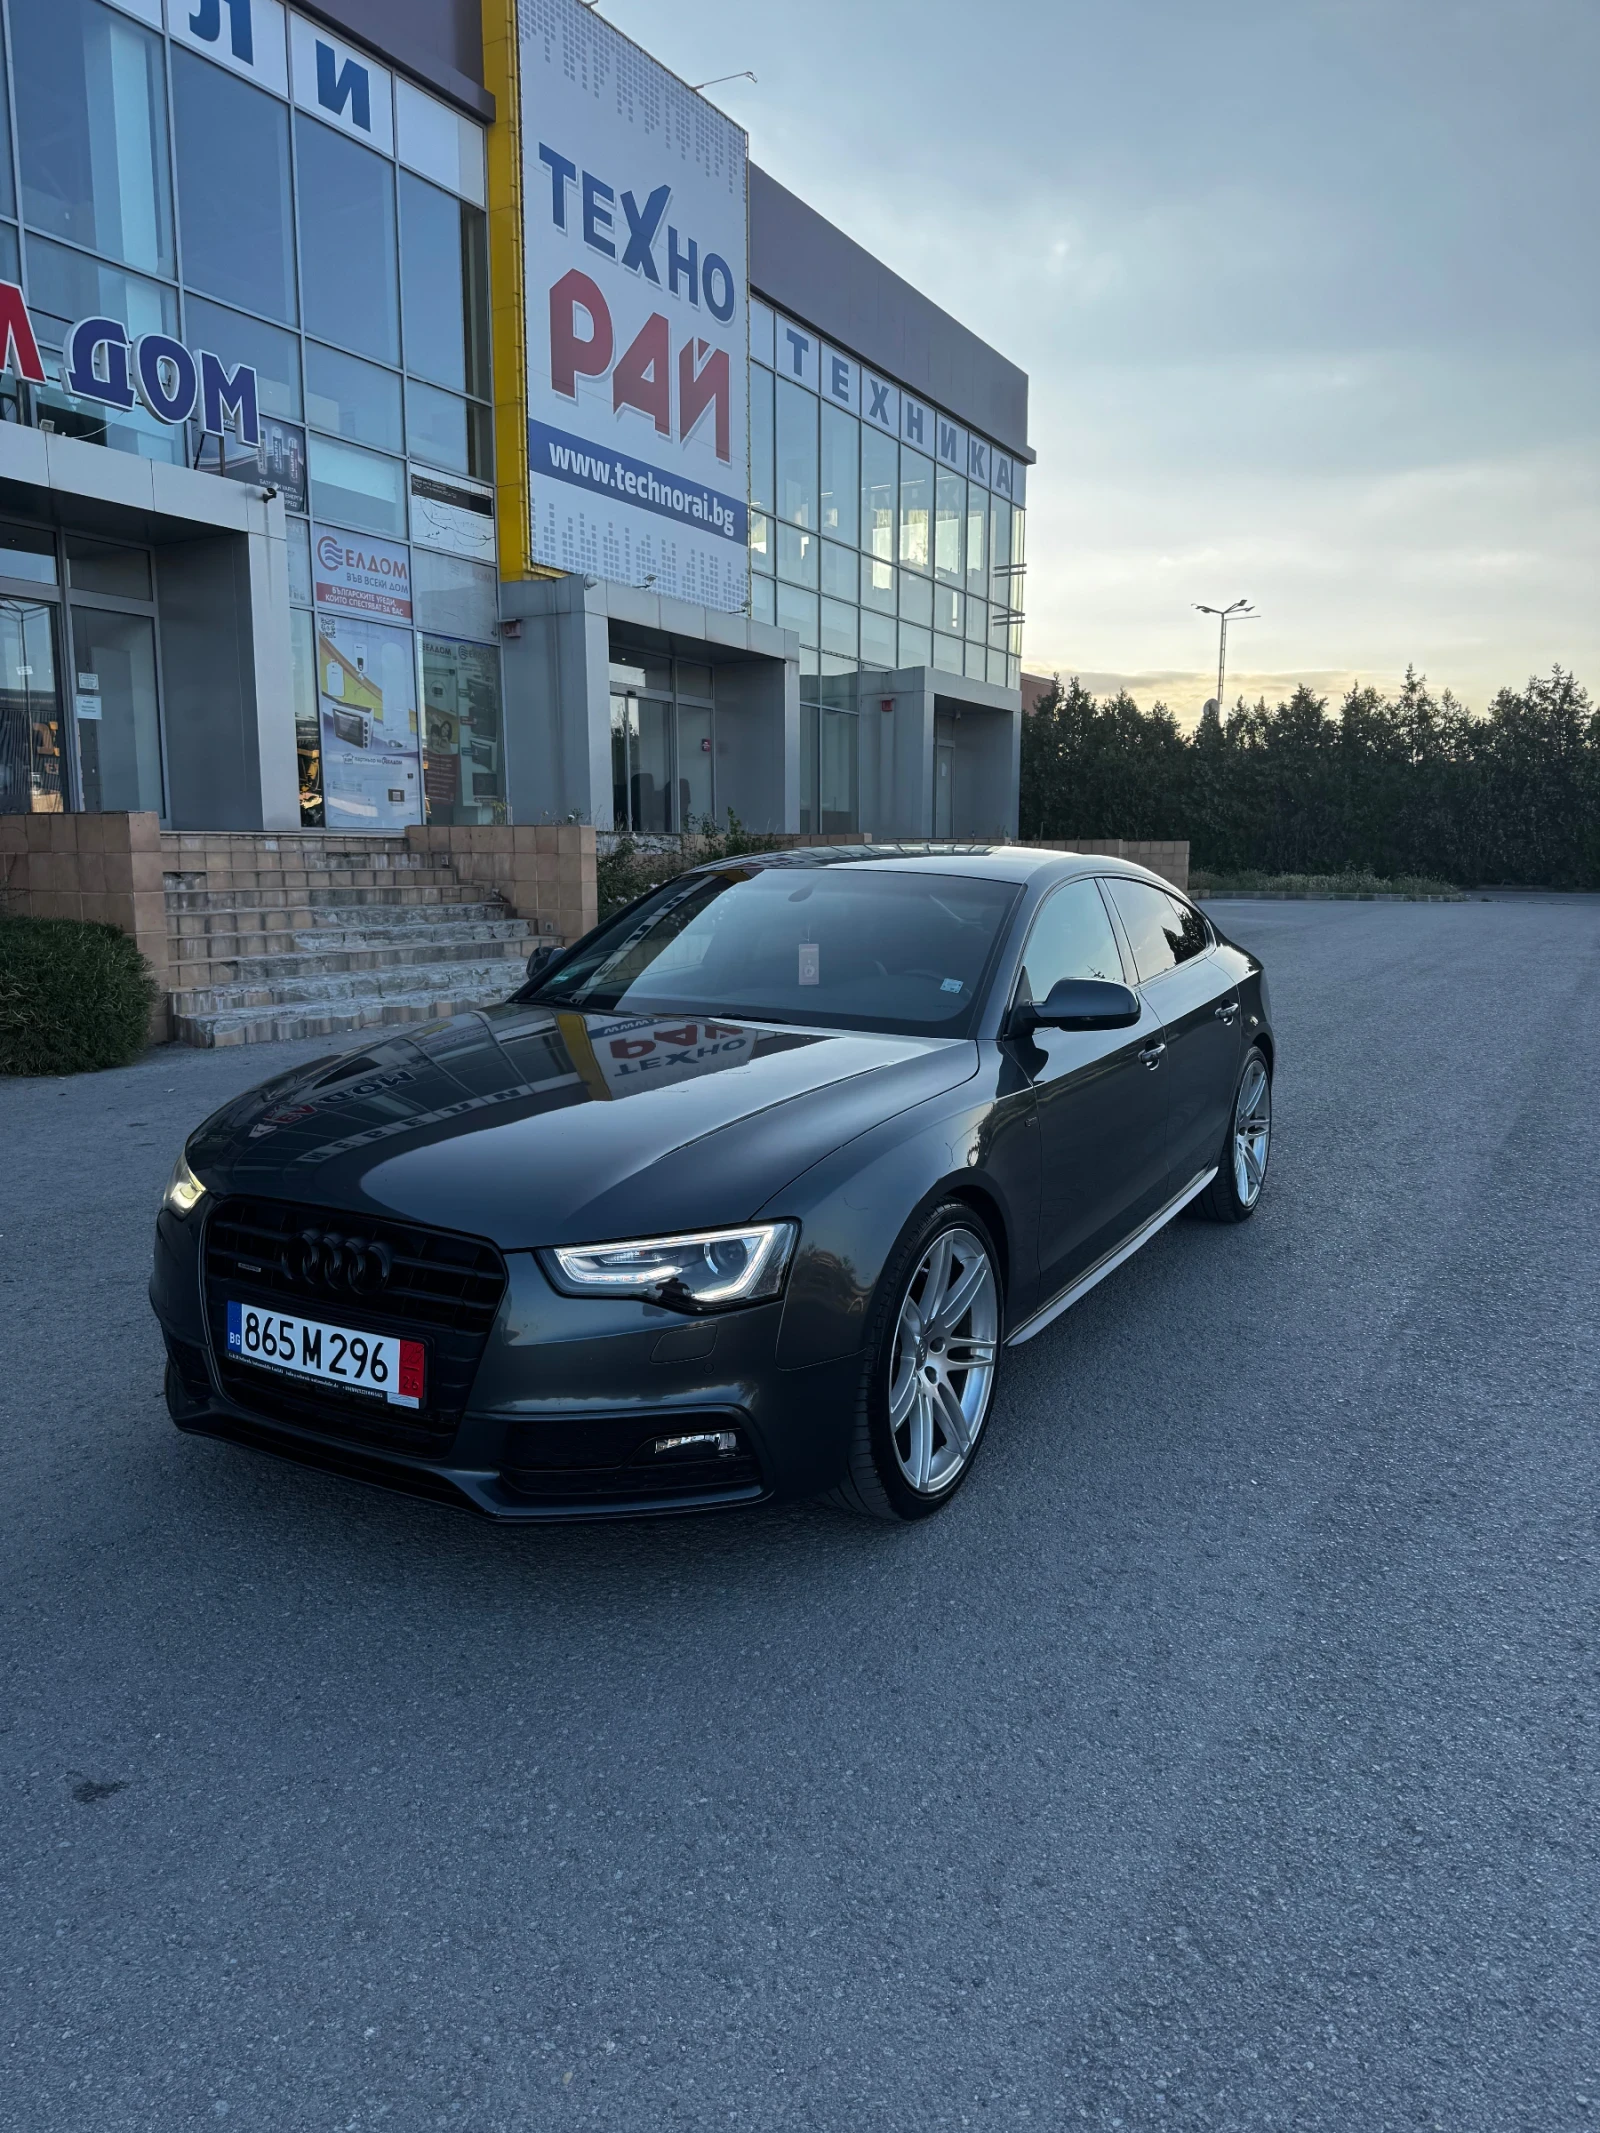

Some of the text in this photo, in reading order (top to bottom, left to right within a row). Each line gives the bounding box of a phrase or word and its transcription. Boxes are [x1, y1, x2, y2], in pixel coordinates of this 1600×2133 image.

[539, 142, 735, 322] ТЕХНО
[549, 268, 730, 463] РАЙ
[787, 328, 1011, 493] ТЕХНИКА
[549, 442, 735, 537] www.technorai.bg
[345, 549, 407, 580] ЕЛДОМ
[332, 587, 374, 602] БЪЛГАРСКИТЕ
[346, 572, 409, 594] ВЪВ ВСЕКИ ДОМ
[325, 594, 404, 616] КОИТО СПЕСТЯВАТ ЗА ВАС
[229, 1331, 241, 1346] BG
[403, 1375, 420, 1391] 26
